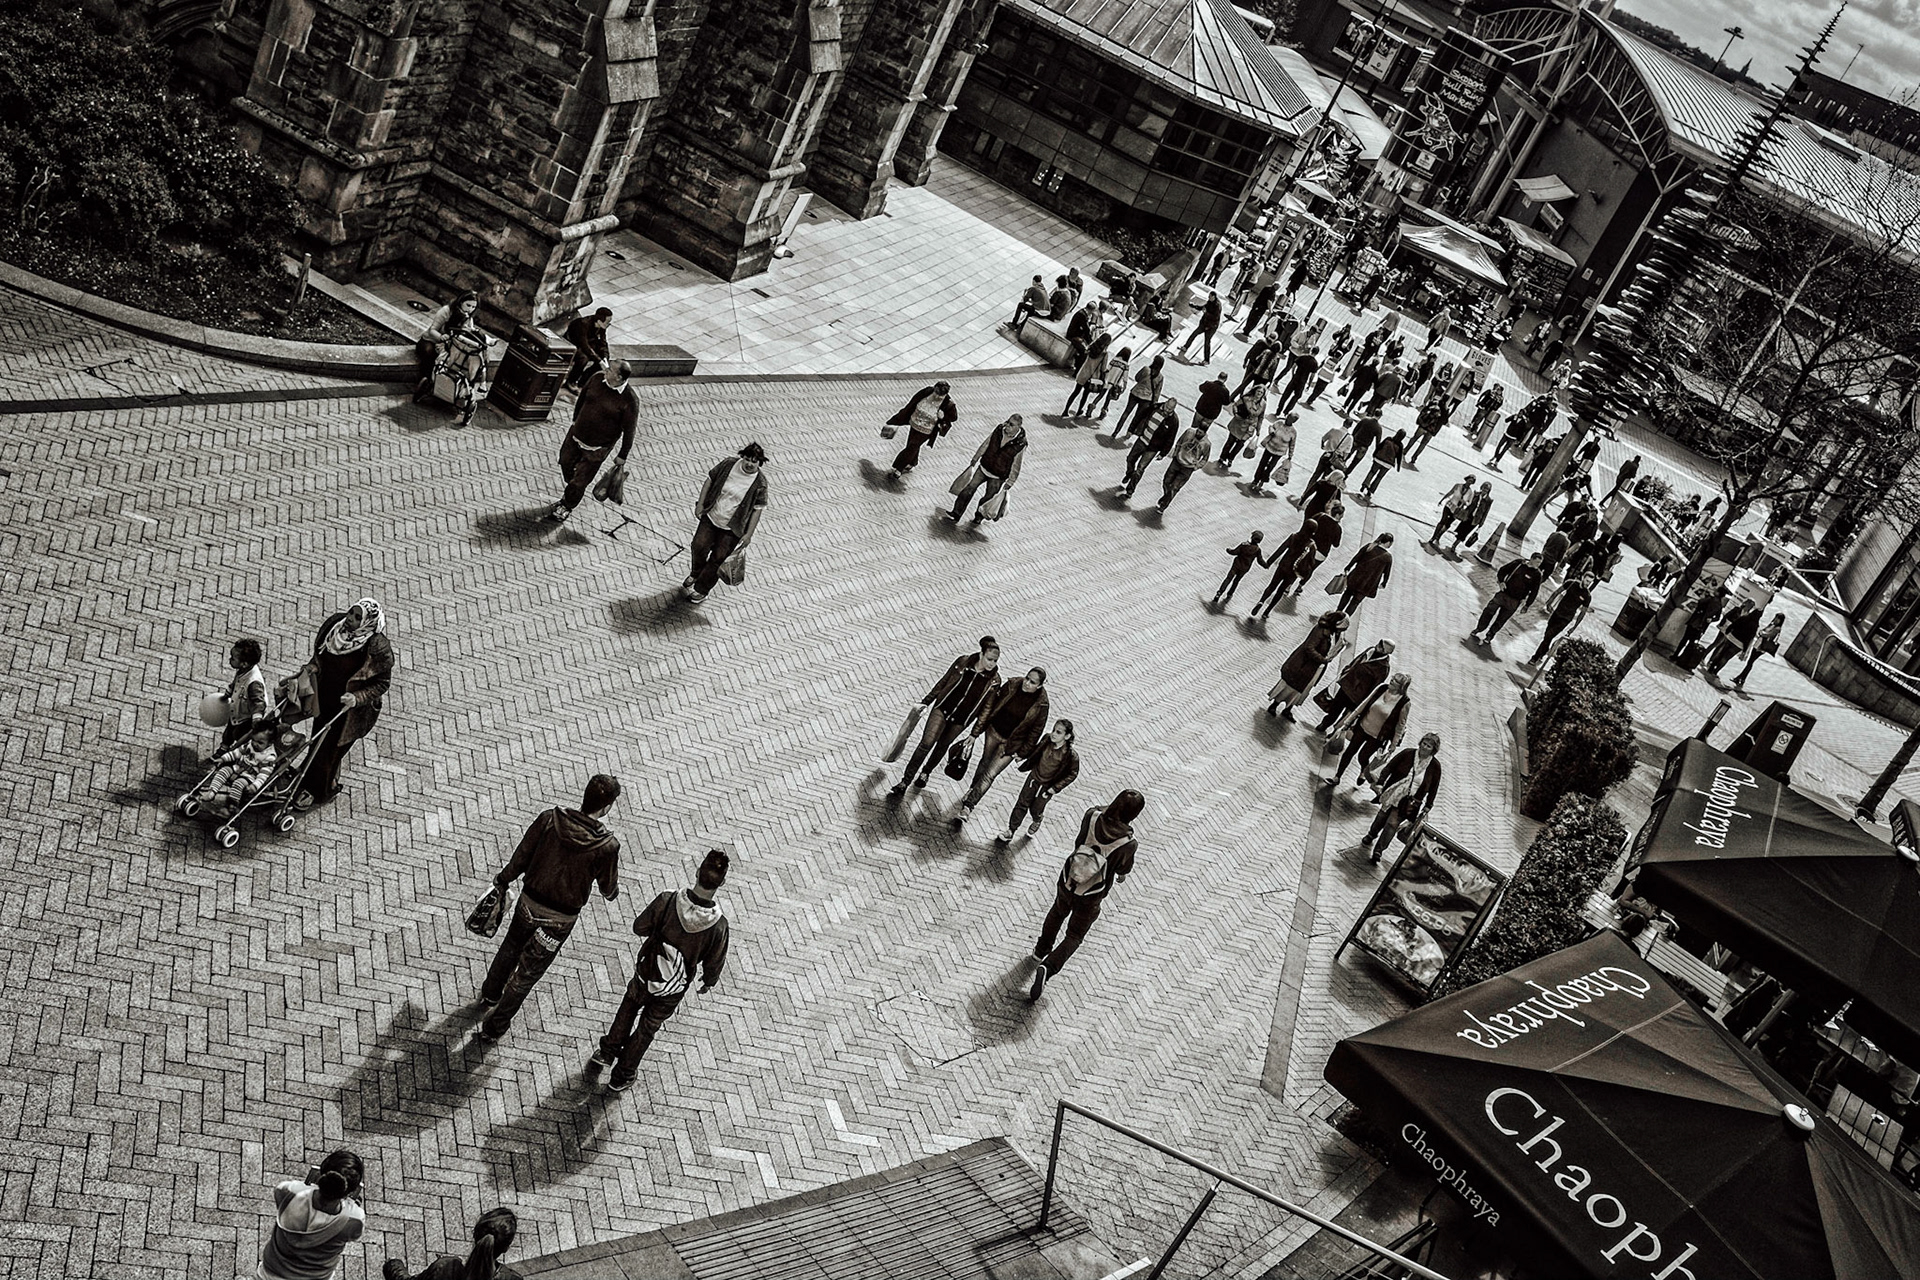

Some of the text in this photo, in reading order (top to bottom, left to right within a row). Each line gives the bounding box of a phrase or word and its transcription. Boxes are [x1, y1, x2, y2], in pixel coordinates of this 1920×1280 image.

[1442, 76, 1484, 105] Bull Ring
[1450, 69, 1486, 92] Supports
[1440, 88, 1476, 110] Markets
[1286, 219, 1301, 231] CASH
[1683, 766, 1759, 849] Chaophraya
[1420, 837, 1458, 868] LUNCH
[1456, 966, 1651, 1049] Chaophraya
[1401, 1123, 1501, 1227] Chaophraya
